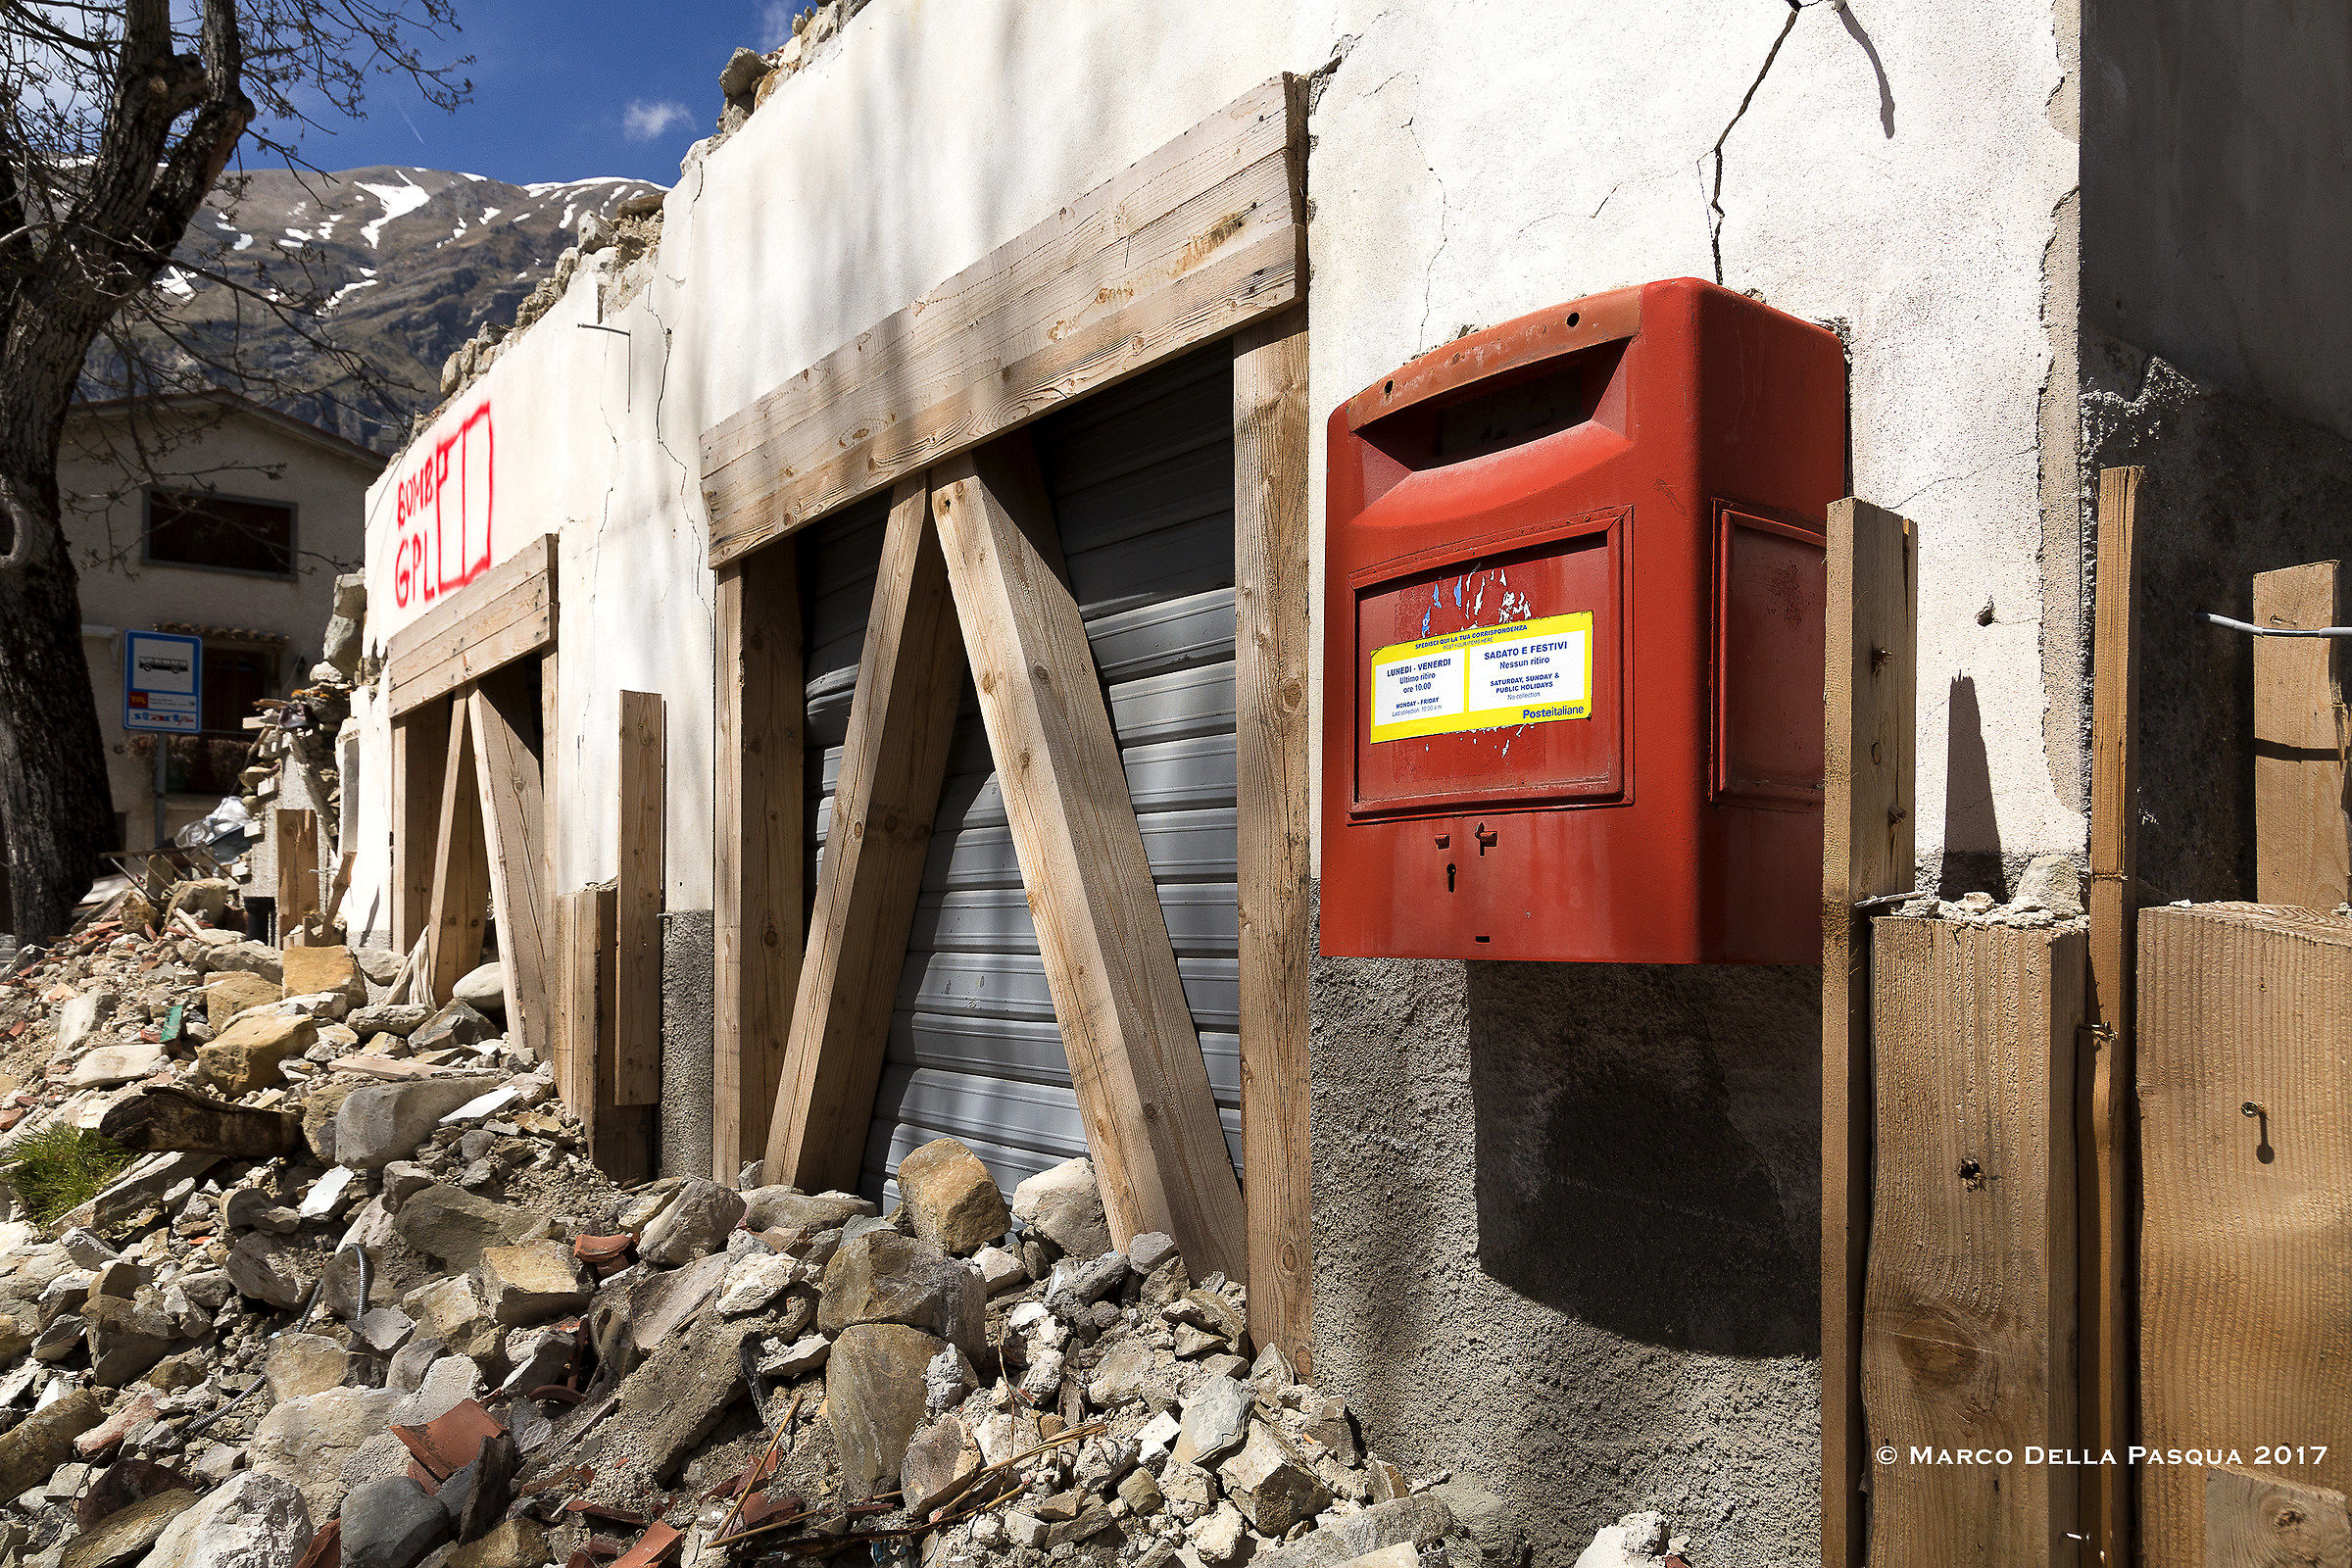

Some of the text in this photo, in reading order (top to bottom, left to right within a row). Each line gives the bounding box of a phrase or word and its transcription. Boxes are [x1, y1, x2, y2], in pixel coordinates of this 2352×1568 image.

[395, 530, 435, 609] GPL
[1415, 640, 1440, 650] SPEDISCI
[1472, 624, 1528, 639] CORRISPONDENZA
[1484, 641, 1568, 661] SABATO E FESTIVI
[1387, 664, 1412, 677] LUNEDI
[1417, 658, 1451, 671] VENERDI
[1499, 656, 1550, 669] Nessun ritiro
[1399, 671, 1436, 684] Ultimo ritiro
[1490, 676, 1524, 687] SATURDAY,
[1525, 673, 1552, 682] SUNDAY
[1415, 681, 1432, 692] 10.00
[1495, 681, 1553, 694] PUBLIC HOLIDAYS
[1515, 691, 1541, 700] collection
[1522, 705, 1585, 719] Posteitaliane
